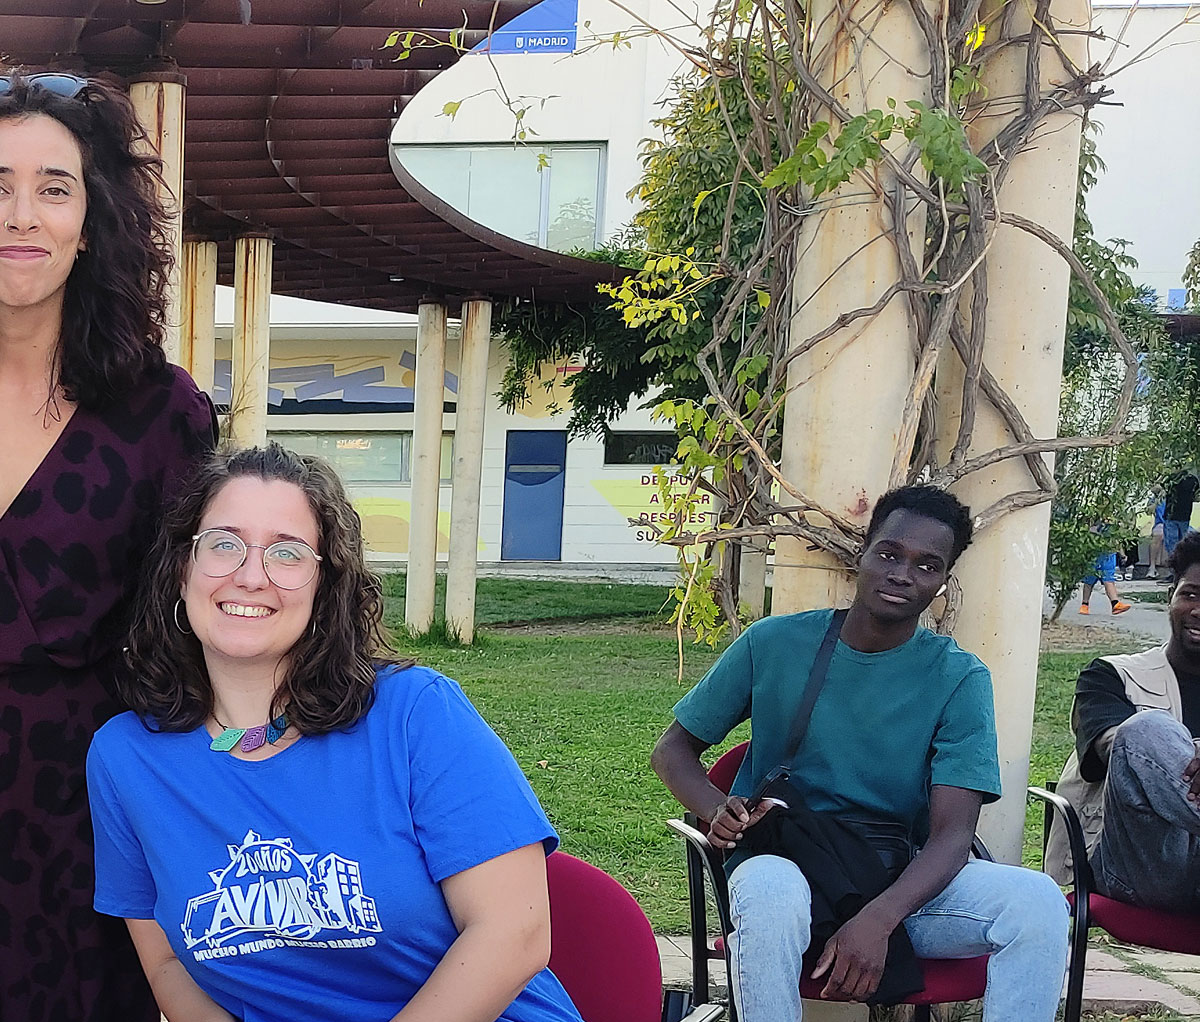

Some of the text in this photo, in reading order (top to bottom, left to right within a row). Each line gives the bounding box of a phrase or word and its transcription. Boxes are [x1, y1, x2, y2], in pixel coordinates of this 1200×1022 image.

[528, 37, 568, 47] MADRID
[235, 852, 259, 877] 20
[193, 944, 237, 962] MUCHO
[240, 937, 285, 956] MUNDO
[327, 936, 376, 949] BARRIO
